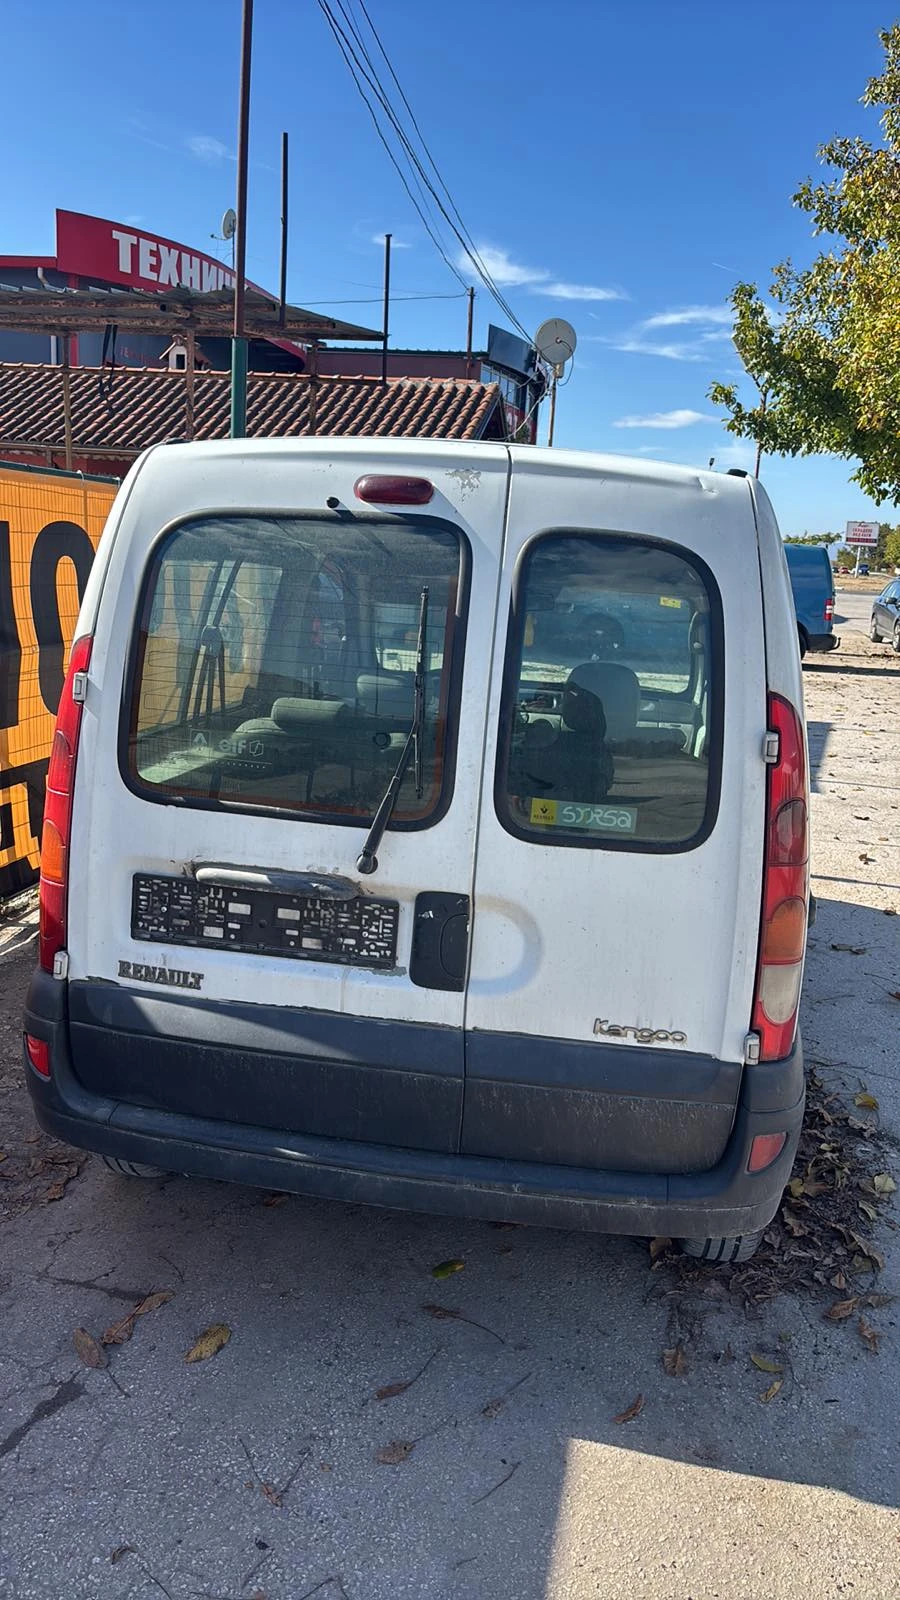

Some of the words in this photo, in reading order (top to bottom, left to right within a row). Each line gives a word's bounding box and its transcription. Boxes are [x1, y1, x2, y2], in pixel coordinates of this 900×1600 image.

[112, 229, 248, 294] ТЕХНИ
[118, 960, 204, 990] RENAULT
[593, 1018, 687, 1044] Kangoo
